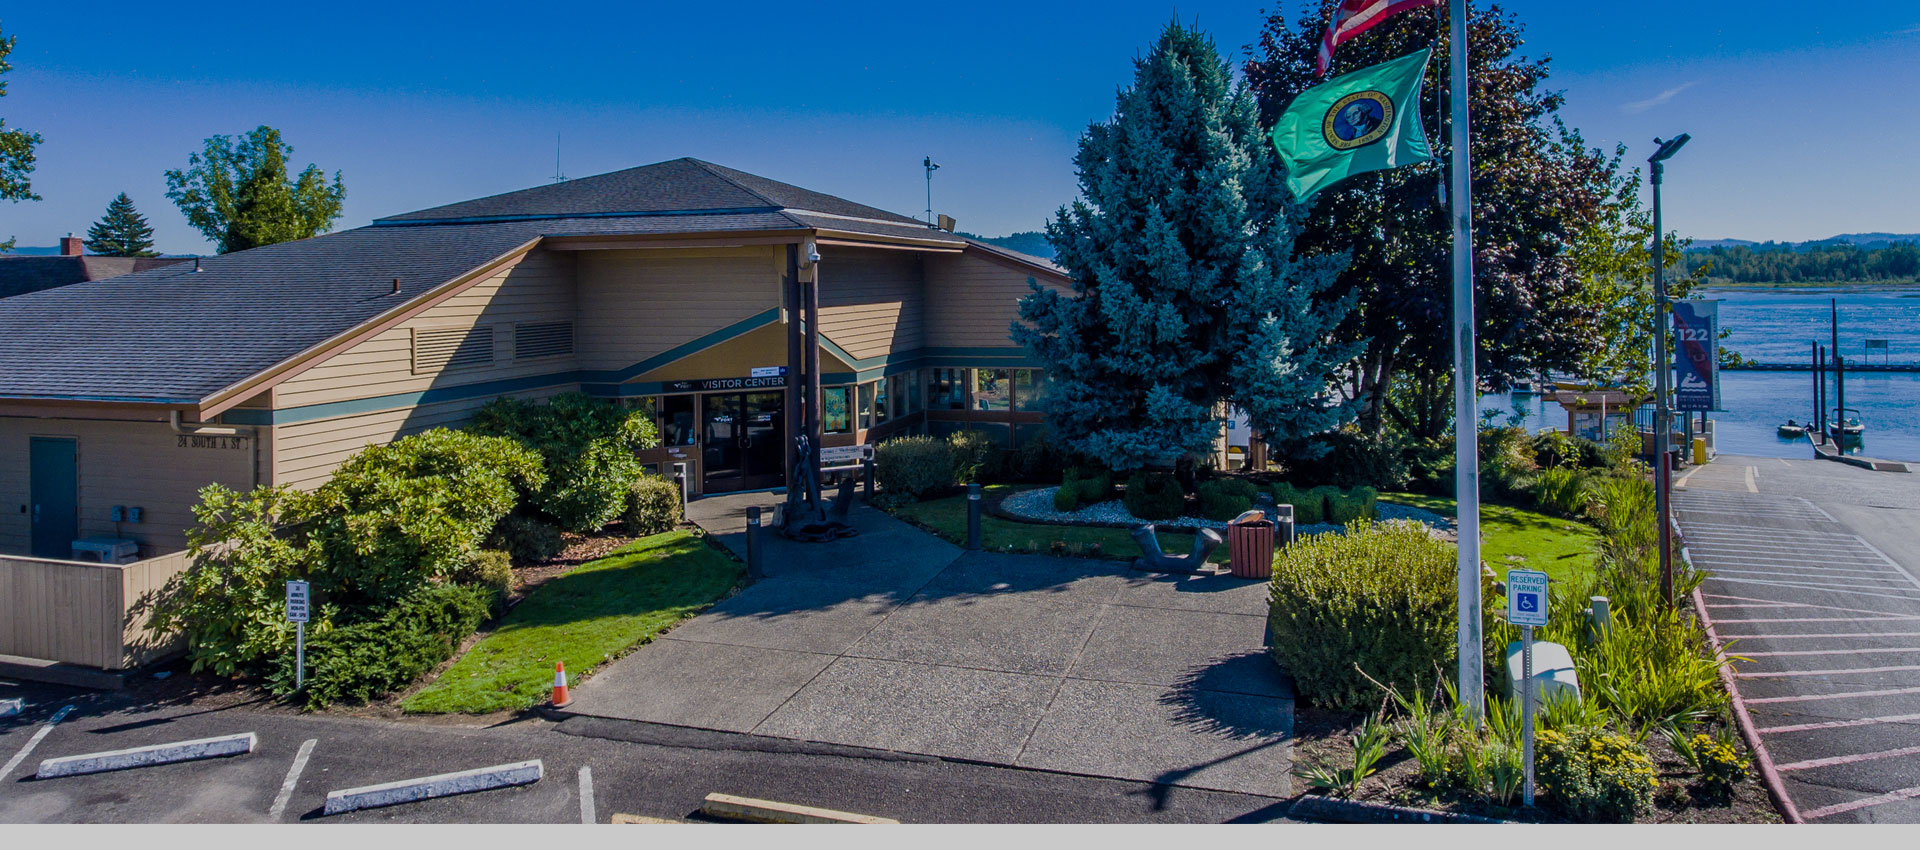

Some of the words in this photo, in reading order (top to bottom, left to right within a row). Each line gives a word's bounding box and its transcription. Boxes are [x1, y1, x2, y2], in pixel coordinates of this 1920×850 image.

[1378, 94, 1393, 136] WASHINGTON
[1678, 328, 1709, 341] 122
[702, 379, 742, 389] VISITOR
[745, 377, 785, 387] CENTER
[177, 435, 187, 448] 24
[192, 435, 217, 449] SOUTH
[221, 437, 227, 449] A
[231, 437, 241, 450] ST
[1510, 576, 1544, 584] RESERVED
[1513, 584, 1542, 592] PARKING
